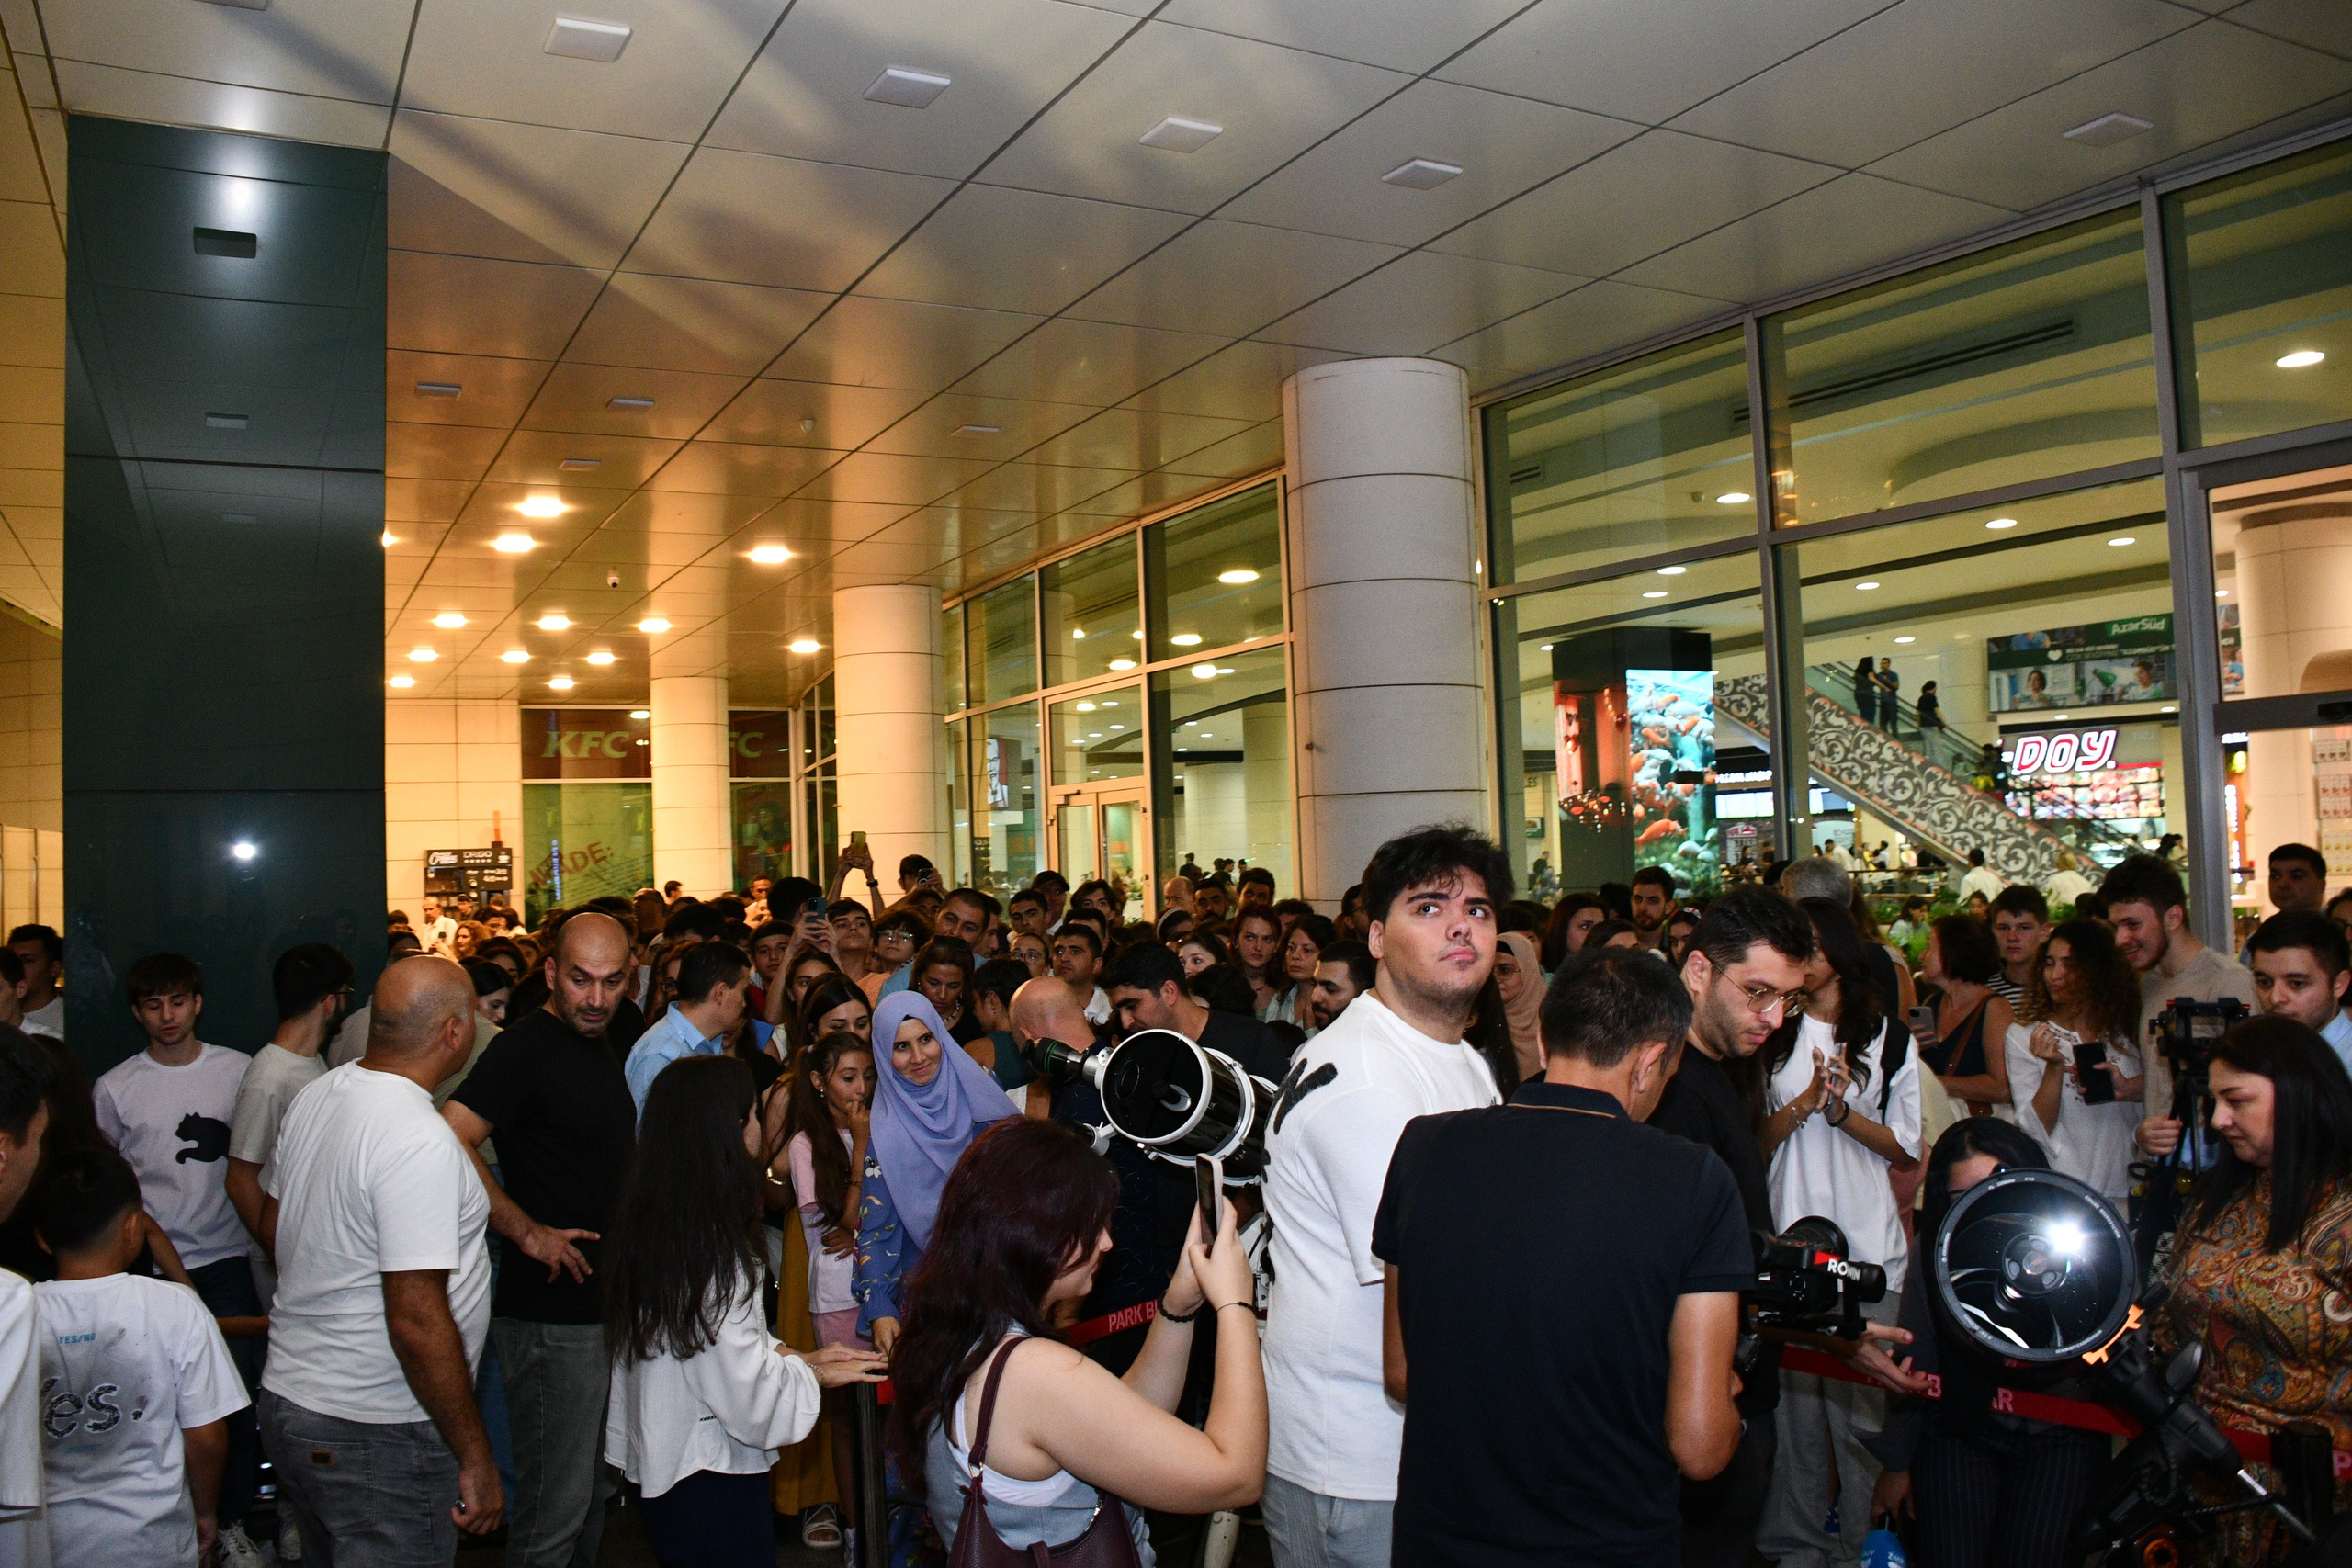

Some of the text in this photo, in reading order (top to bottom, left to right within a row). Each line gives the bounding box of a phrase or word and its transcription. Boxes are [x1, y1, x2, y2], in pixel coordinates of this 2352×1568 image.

[540, 730, 630, 758] KFC
[1108, 1303, 1144, 1333] PARK
[58, 1332, 96, 1345] YES/NO
